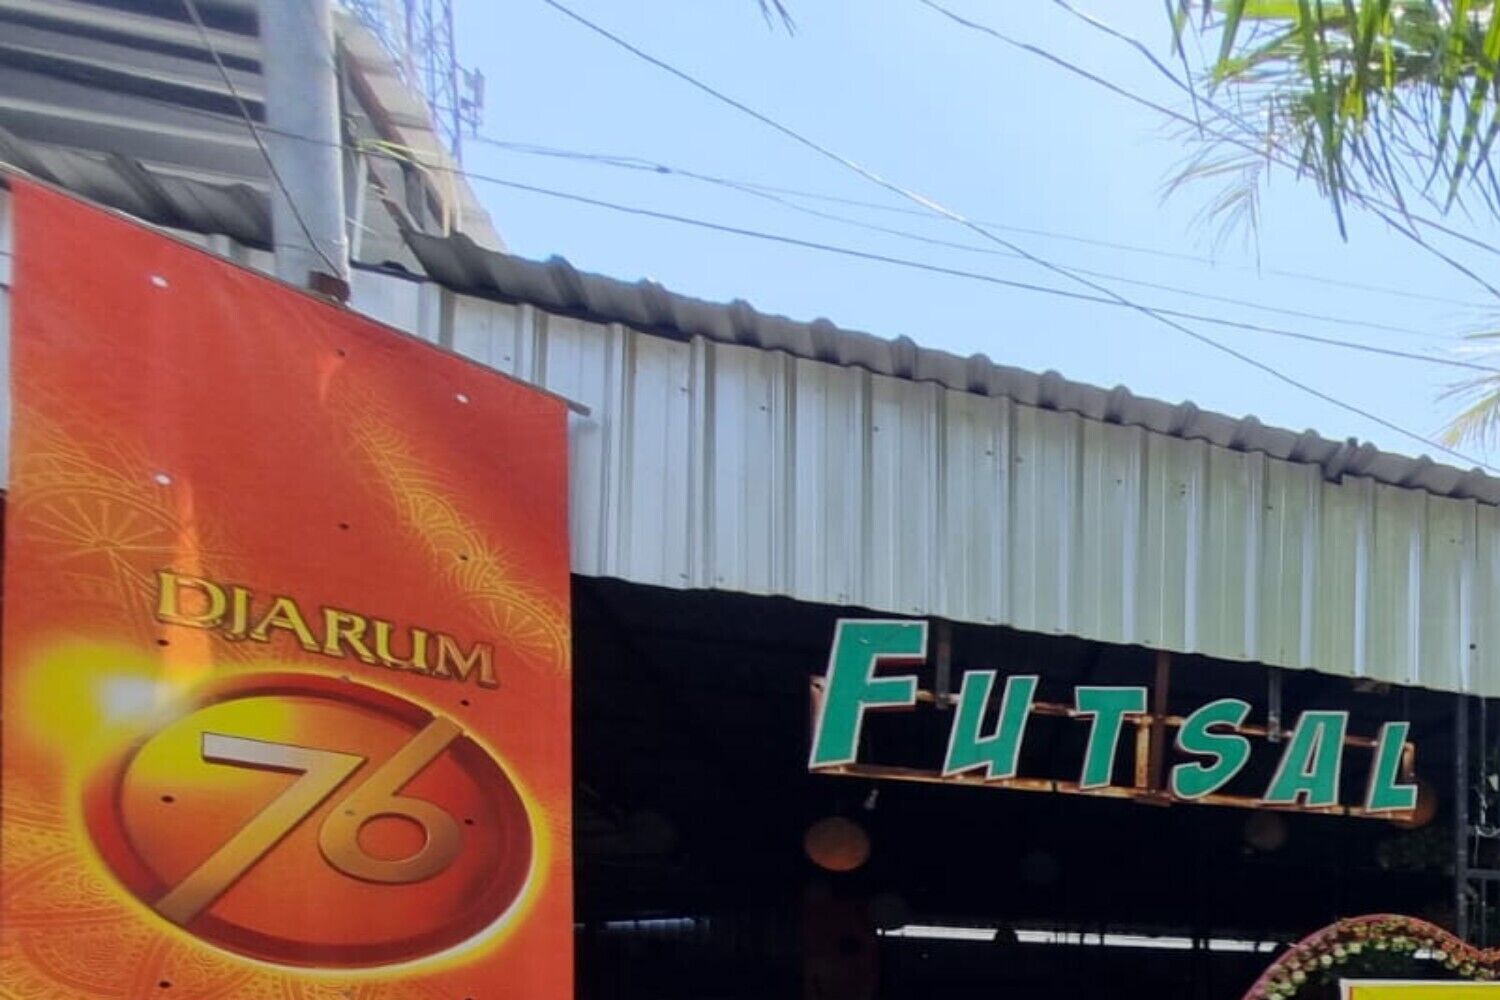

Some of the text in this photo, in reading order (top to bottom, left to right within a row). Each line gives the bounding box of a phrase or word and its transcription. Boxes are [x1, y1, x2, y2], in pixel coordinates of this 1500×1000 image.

[157, 569, 499, 687] DJARUM
[808, 618, 1419, 813] FUTSAL
[154, 713, 465, 926] 76
